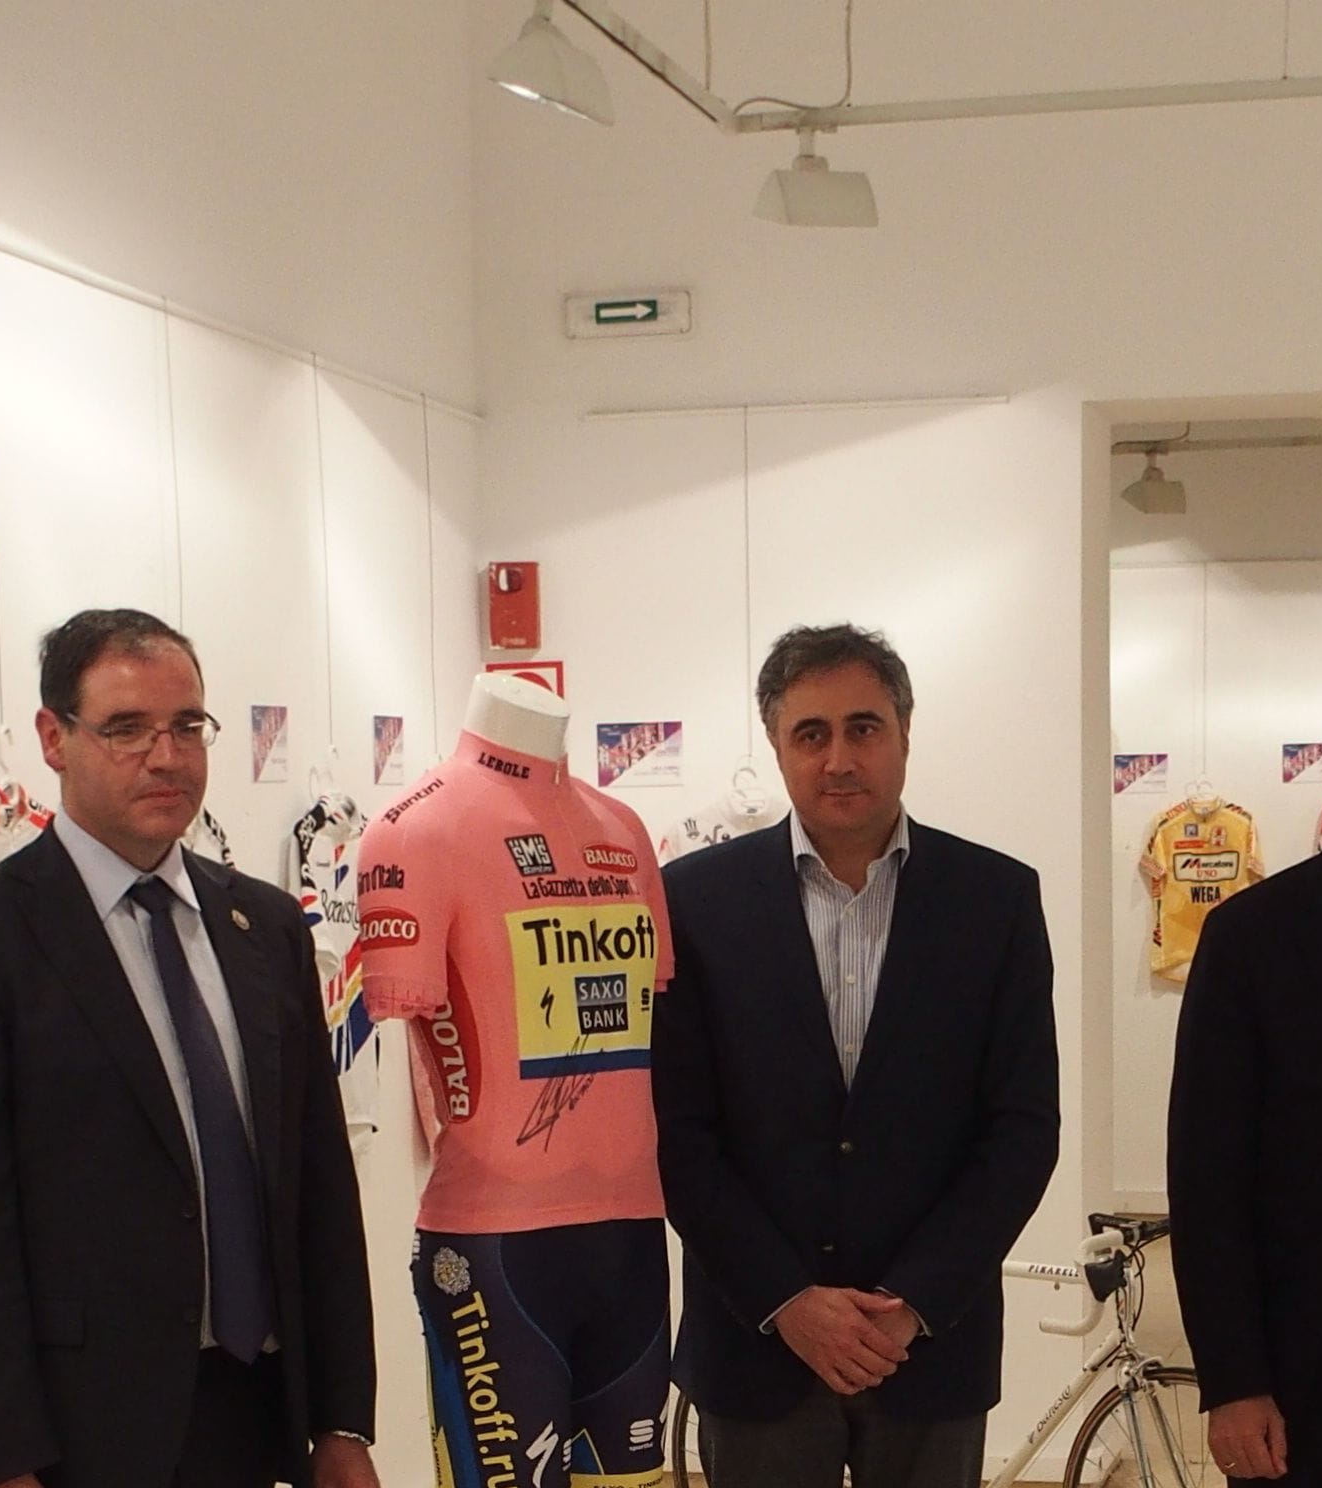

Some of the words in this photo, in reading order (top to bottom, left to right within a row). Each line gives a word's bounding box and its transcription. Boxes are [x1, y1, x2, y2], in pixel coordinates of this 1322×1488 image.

[381, 778, 446, 825] Santini
[585, 850, 637, 868] BALOCCO
[1197, 869, 1218, 878] UNO
[1190, 886, 1221, 904] WEGA
[522, 914, 655, 967] Tinkoff
[580, 979, 624, 1001] SAXO
[582, 1007, 626, 1030] BANK
